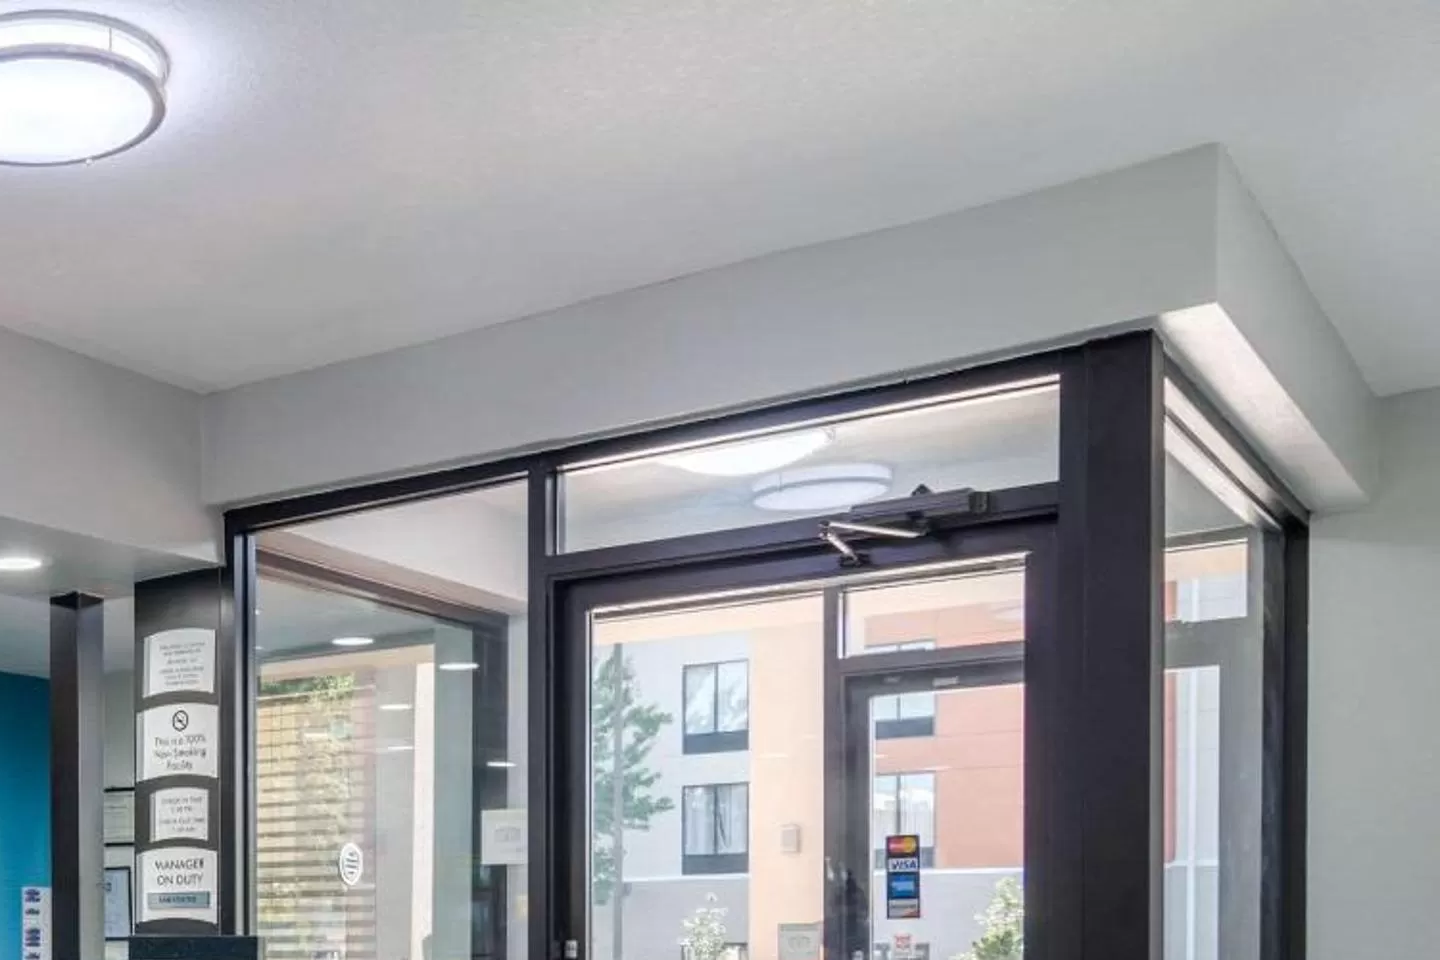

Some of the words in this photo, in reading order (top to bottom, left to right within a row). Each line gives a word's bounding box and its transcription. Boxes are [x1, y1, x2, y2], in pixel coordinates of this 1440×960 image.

[154, 858, 205, 870] MANAGER
[891, 860, 918, 870] VISA
[157, 875, 174, 886] ON
[176, 873, 204, 886] DUTY
